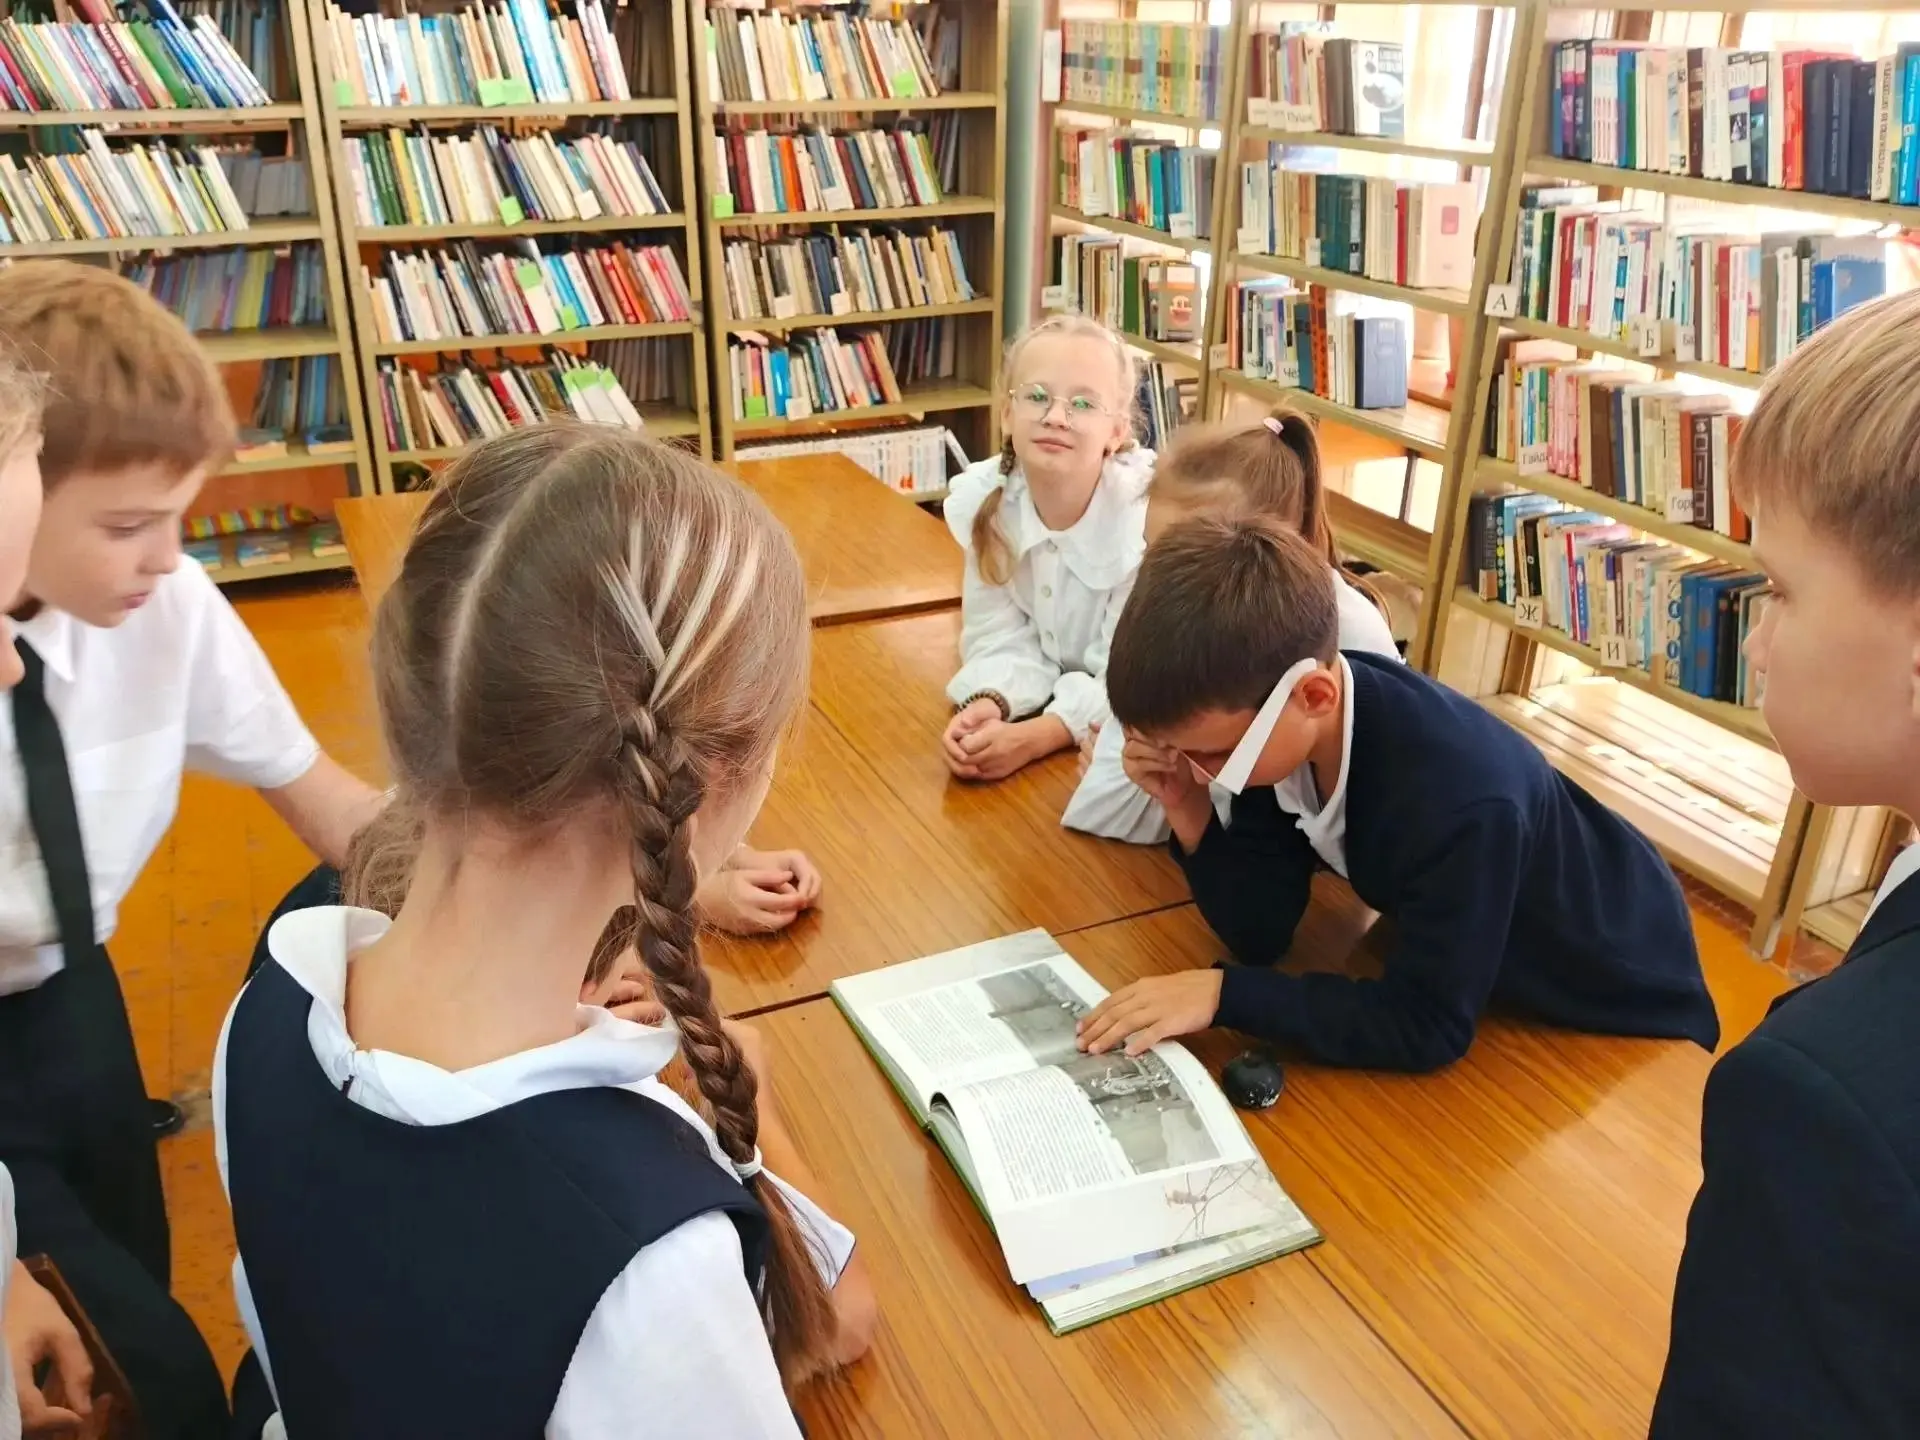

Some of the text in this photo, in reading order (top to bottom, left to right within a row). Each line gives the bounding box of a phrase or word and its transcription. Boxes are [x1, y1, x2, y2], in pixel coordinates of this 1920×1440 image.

[1492, 293, 1507, 311] А
[1646, 328, 1655, 349] Б
[1519, 602, 1538, 622] Ж
[1607, 641, 1620, 661] И
